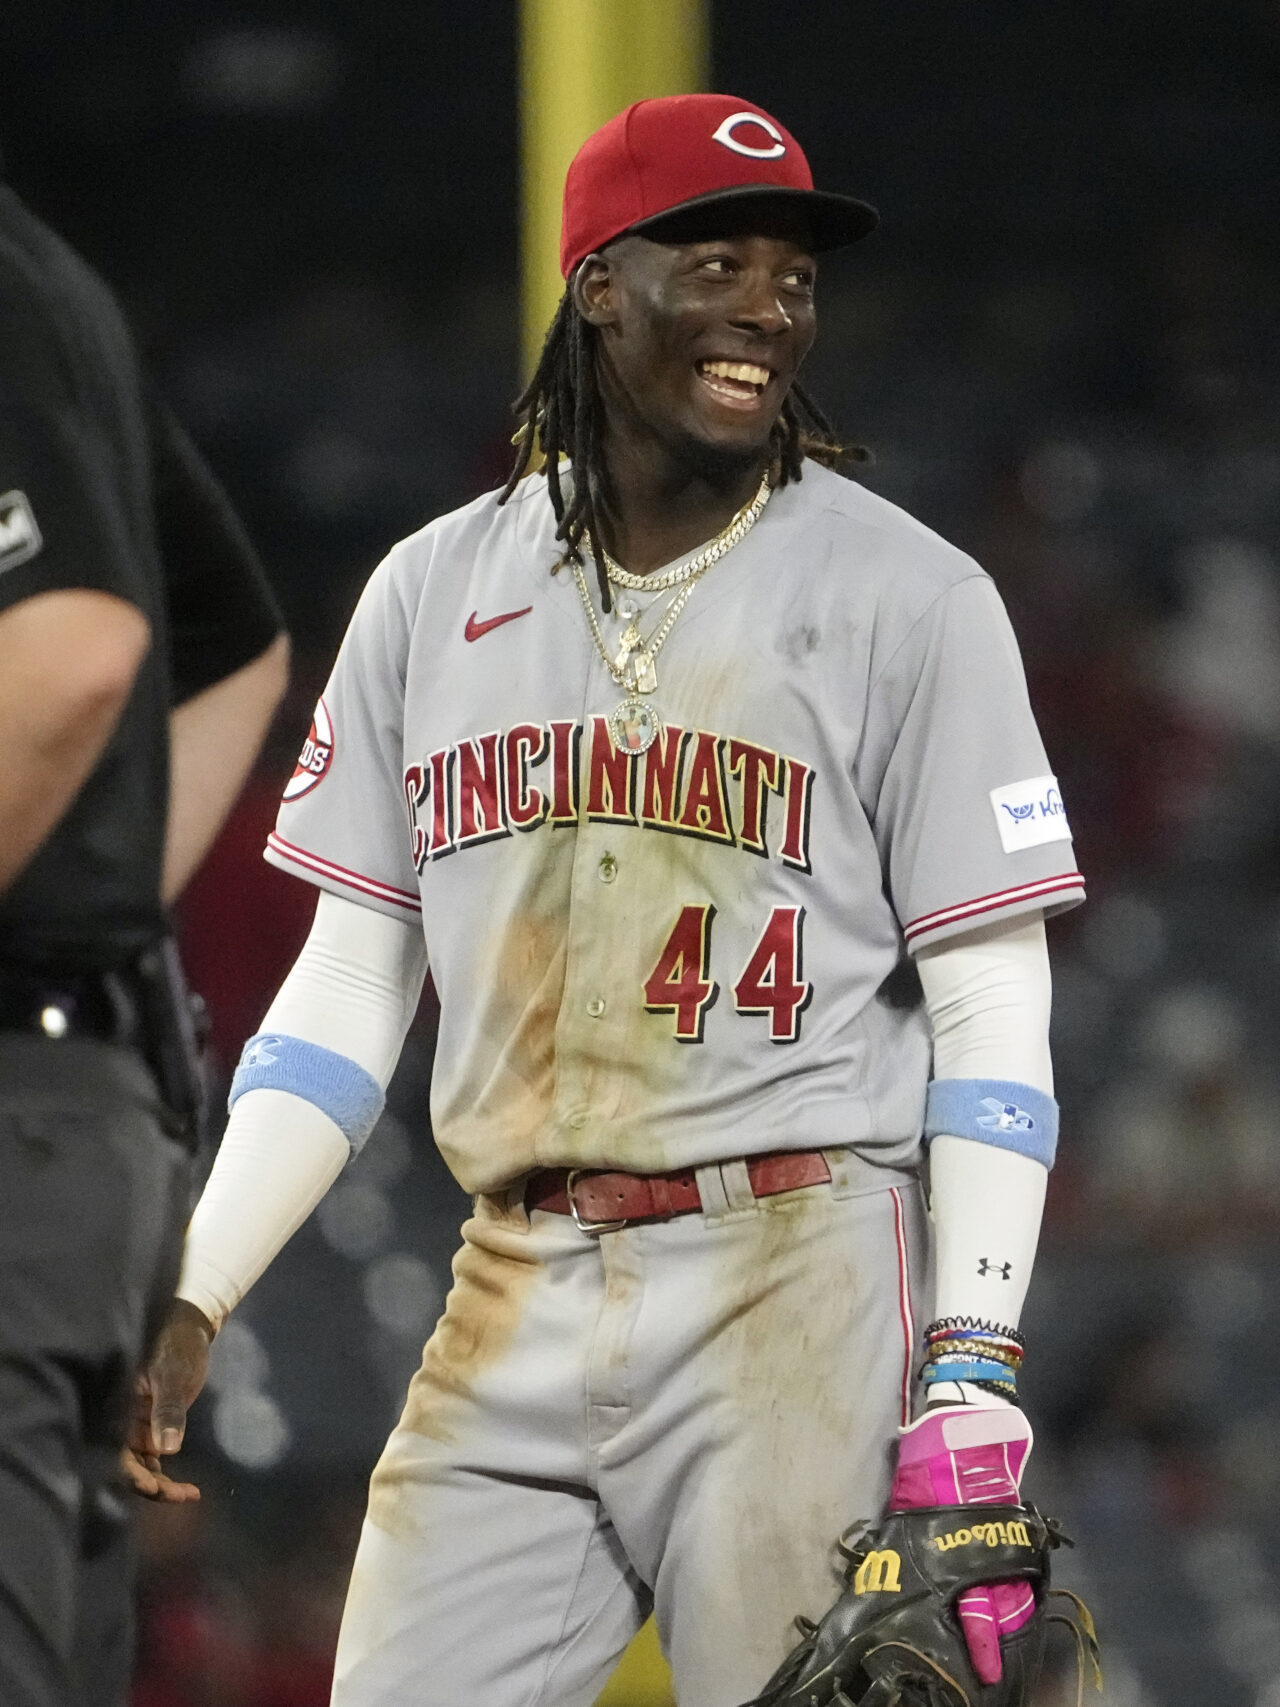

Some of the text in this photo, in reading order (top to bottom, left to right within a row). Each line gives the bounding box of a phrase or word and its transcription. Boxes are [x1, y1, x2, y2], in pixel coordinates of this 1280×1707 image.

[712, 112, 787, 161] C
[298, 738, 330, 775] DS
[403, 713, 817, 876] CINCINNATI
[641, 902, 815, 1046] 44
[933, 1520, 1033, 1553] Wilson
